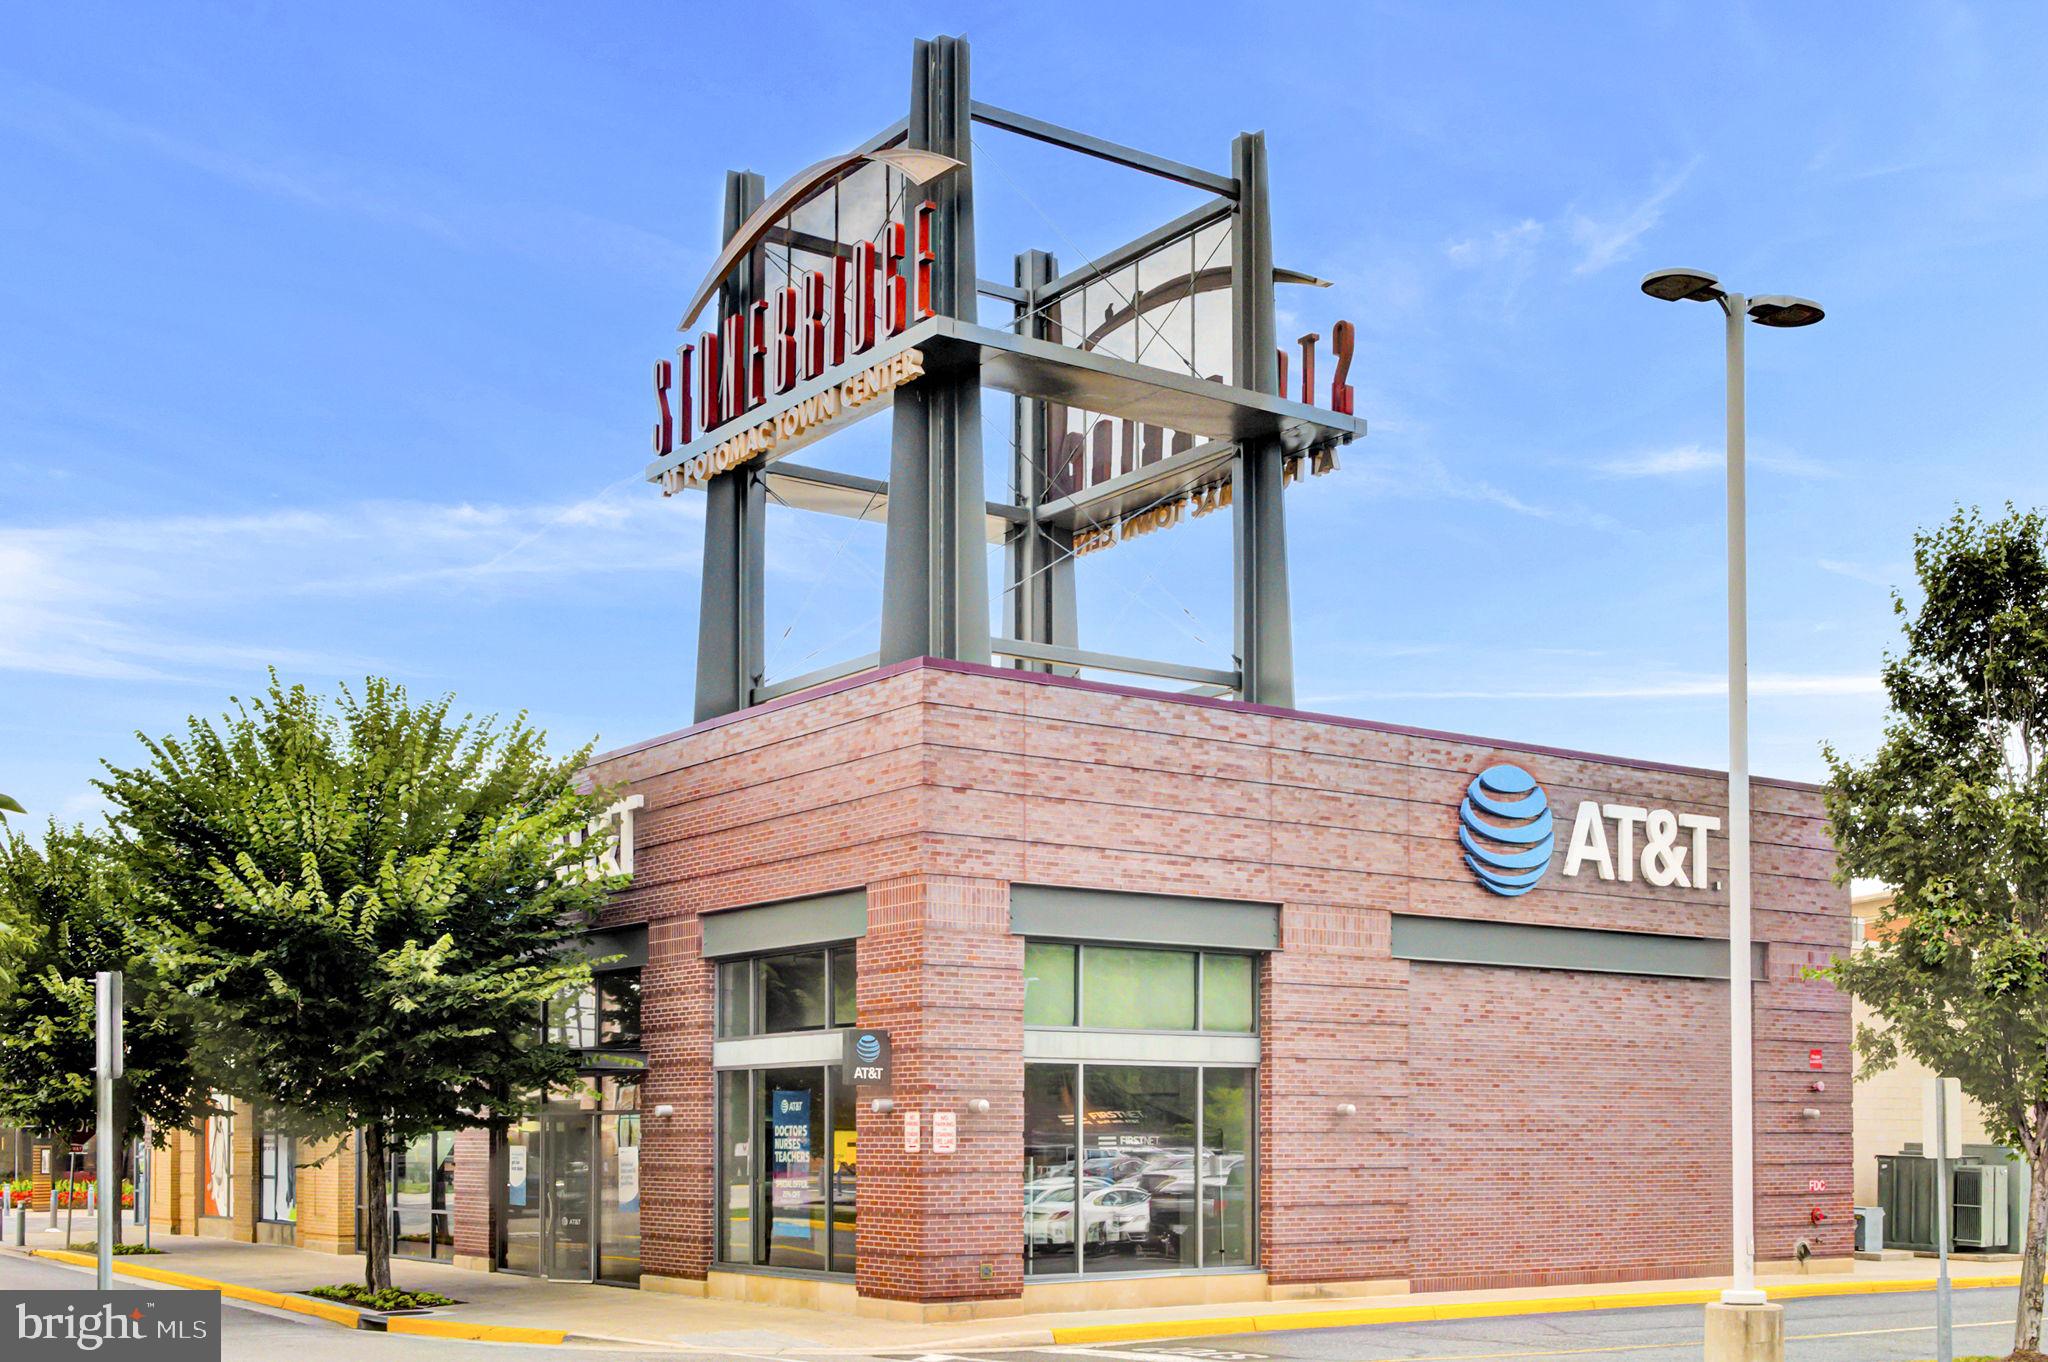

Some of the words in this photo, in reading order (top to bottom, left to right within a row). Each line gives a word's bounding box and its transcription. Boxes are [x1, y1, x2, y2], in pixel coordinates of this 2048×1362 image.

[653, 200, 936, 456] STONEBRIDGE
[662, 470, 685, 497] AT
[684, 421, 776, 482] POTOMAC
[775, 386, 842, 440] TOWN
[840, 346, 926, 408] CENTER
[1562, 800, 1721, 890] AT&T
[853, 1066, 884, 1080] AT&T
[789, 1101, 803, 1111] AT&T
[774, 1125, 808, 1137] DOCTORS
[774, 1137, 801, 1149] NURSES
[774, 1151, 810, 1162] TEACHERS
[1809, 1180, 1825, 1191] FDC
